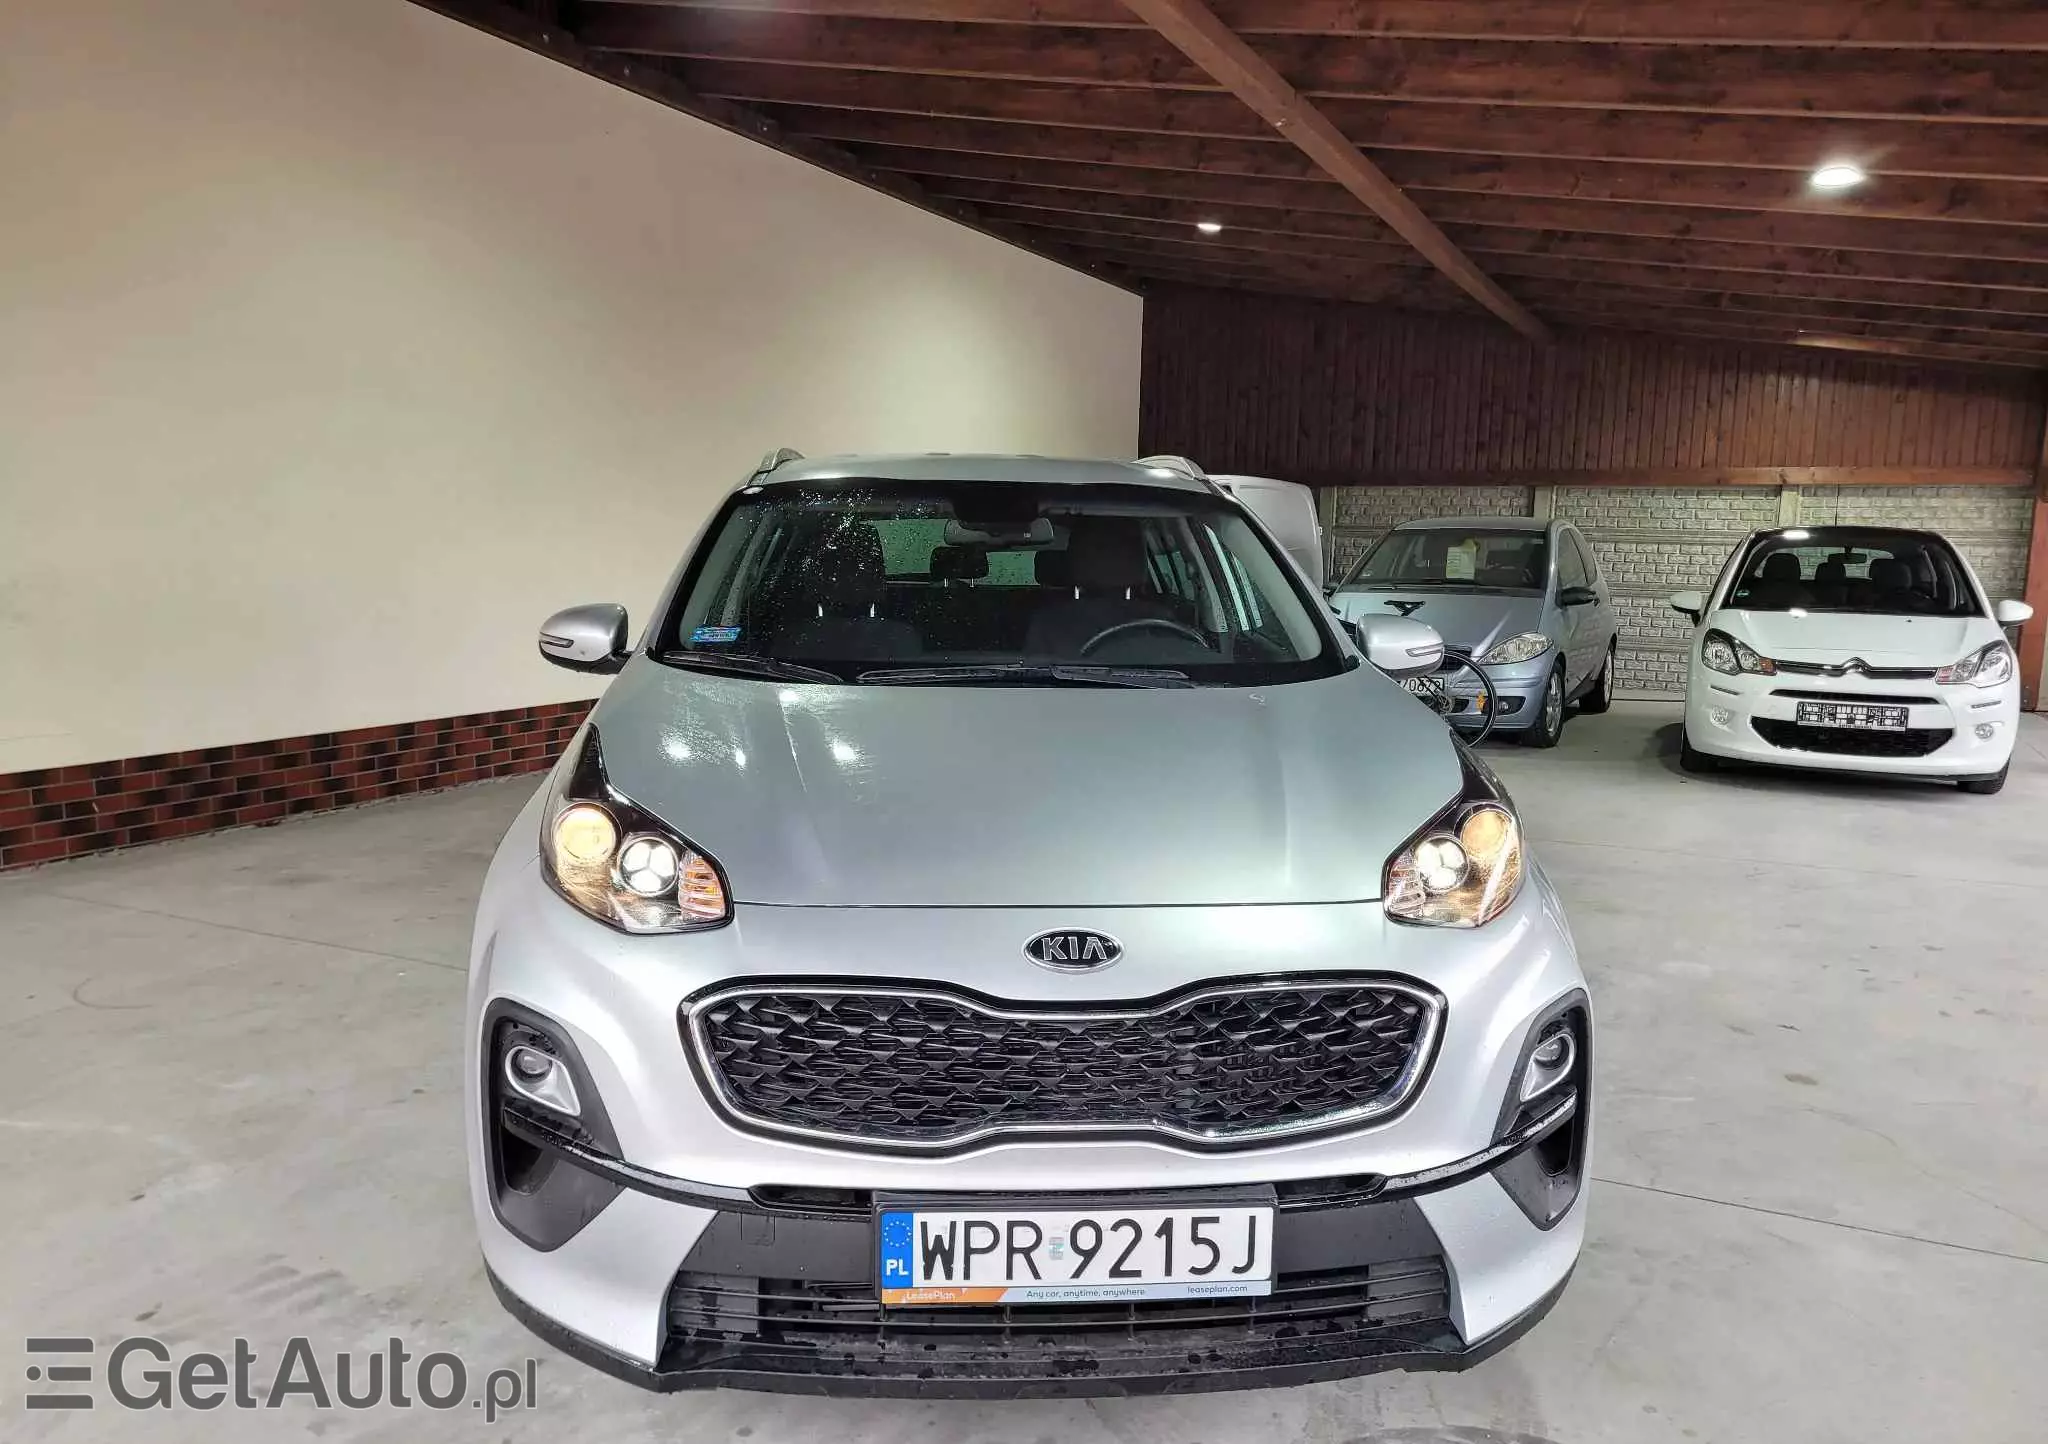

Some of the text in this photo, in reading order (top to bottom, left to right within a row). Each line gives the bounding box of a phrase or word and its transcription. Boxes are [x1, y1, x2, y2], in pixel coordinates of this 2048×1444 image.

[1041, 936, 1107, 960] KIA
[920, 1215, 1256, 1281] WPR 9215J
[886, 1259, 908, 1276] PL
[1026, 1287, 1145, 1299] Any car, anytime, anywhere
[1187, 1285, 1248, 1294] leaseplan.com
